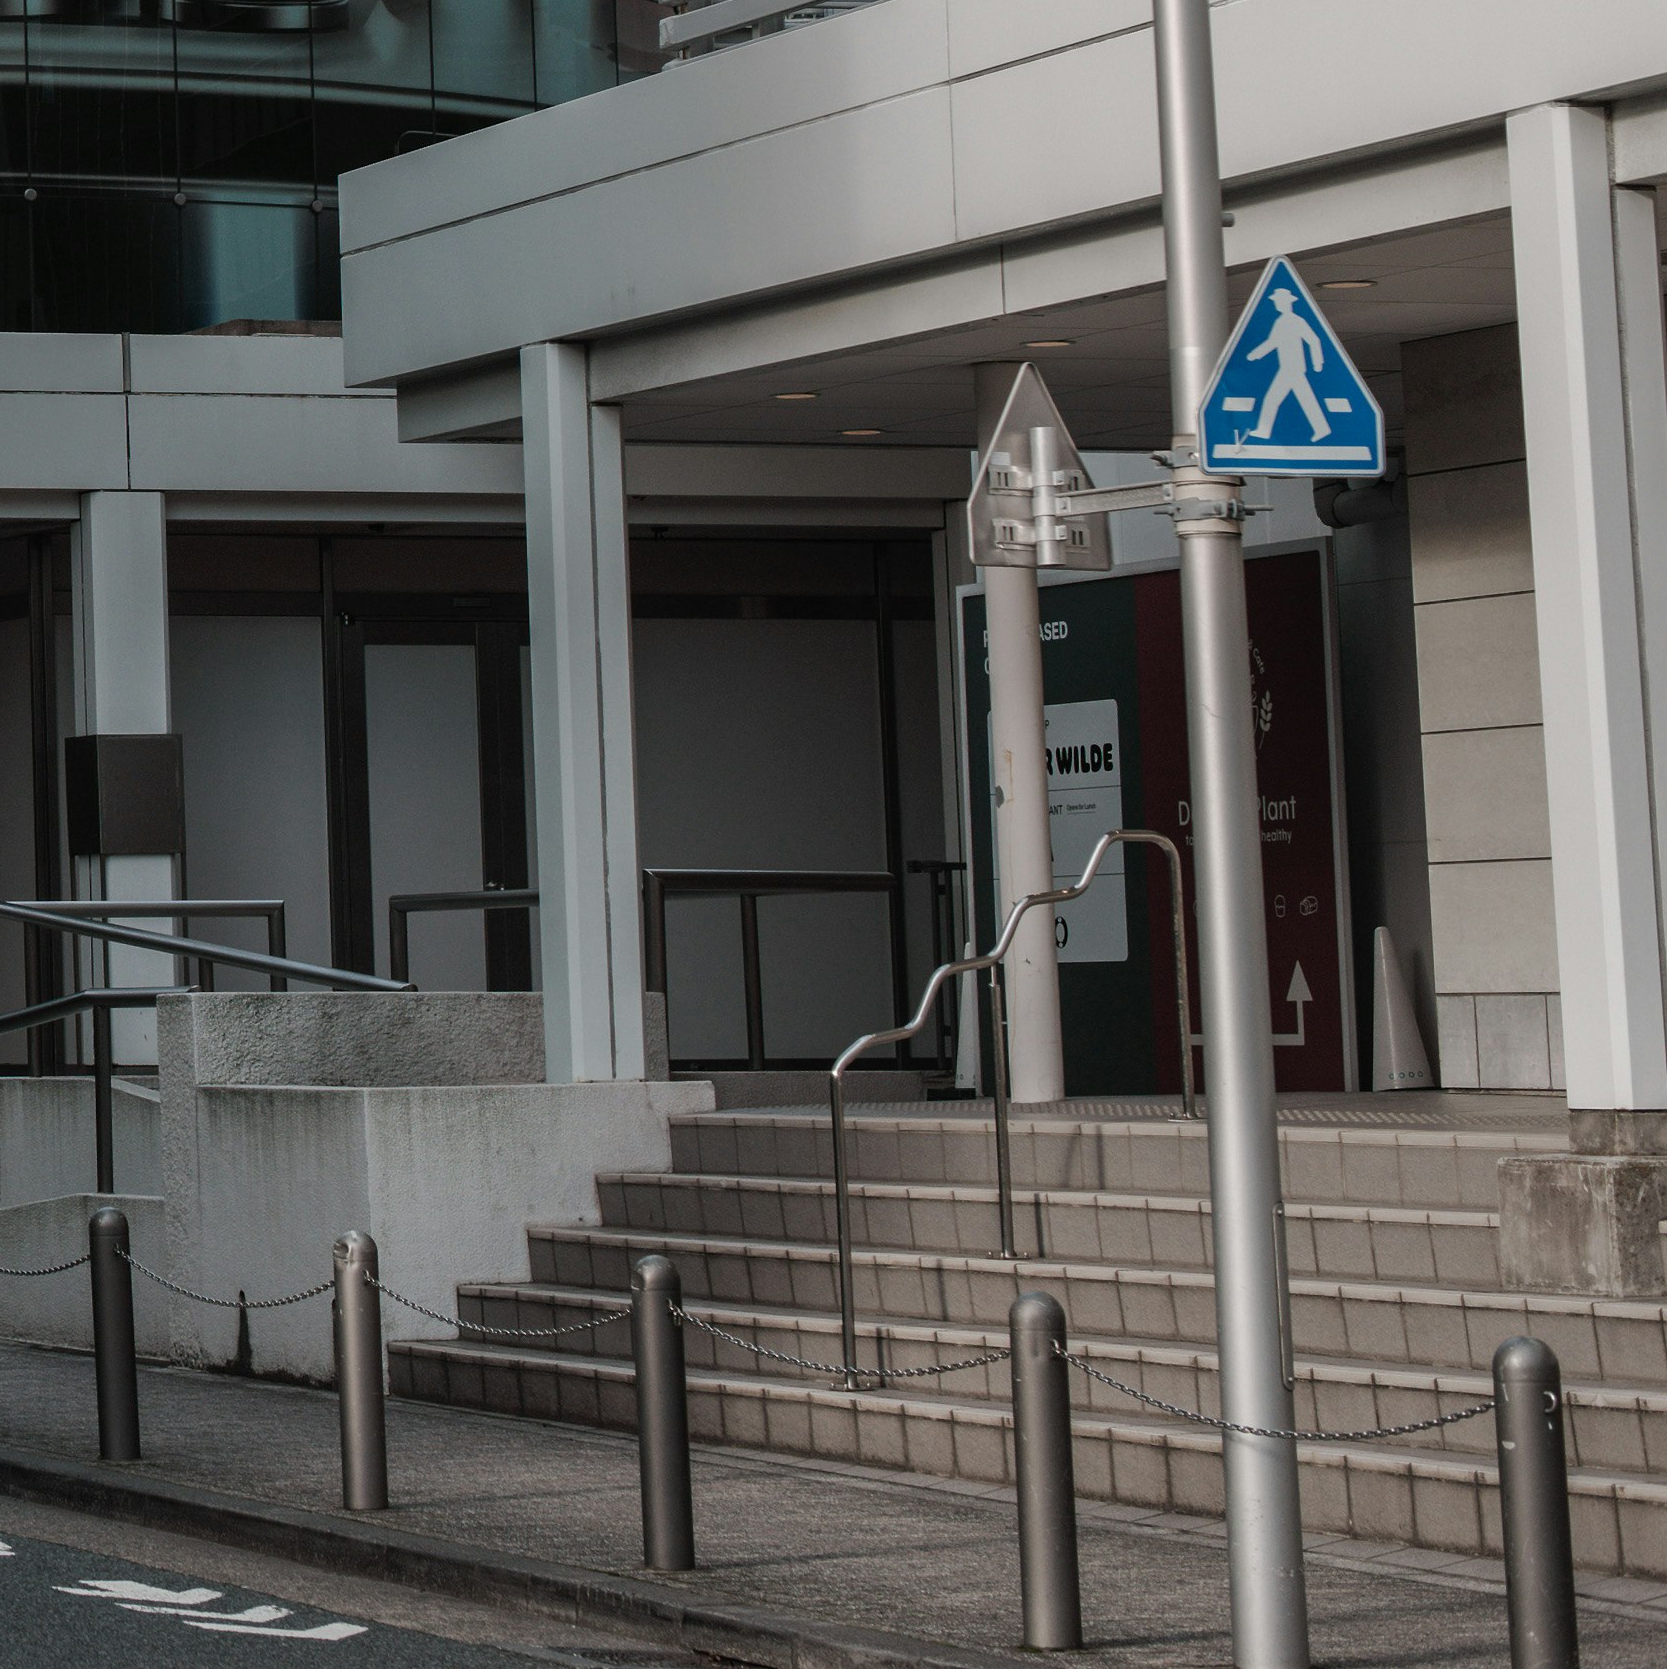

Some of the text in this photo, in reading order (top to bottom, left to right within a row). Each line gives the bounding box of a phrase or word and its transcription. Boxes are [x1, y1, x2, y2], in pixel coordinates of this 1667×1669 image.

[1039, 620, 1069, 642] ASED
[1055, 743, 1114, 775] WILDE
[1261, 828, 1293, 845] healthy
